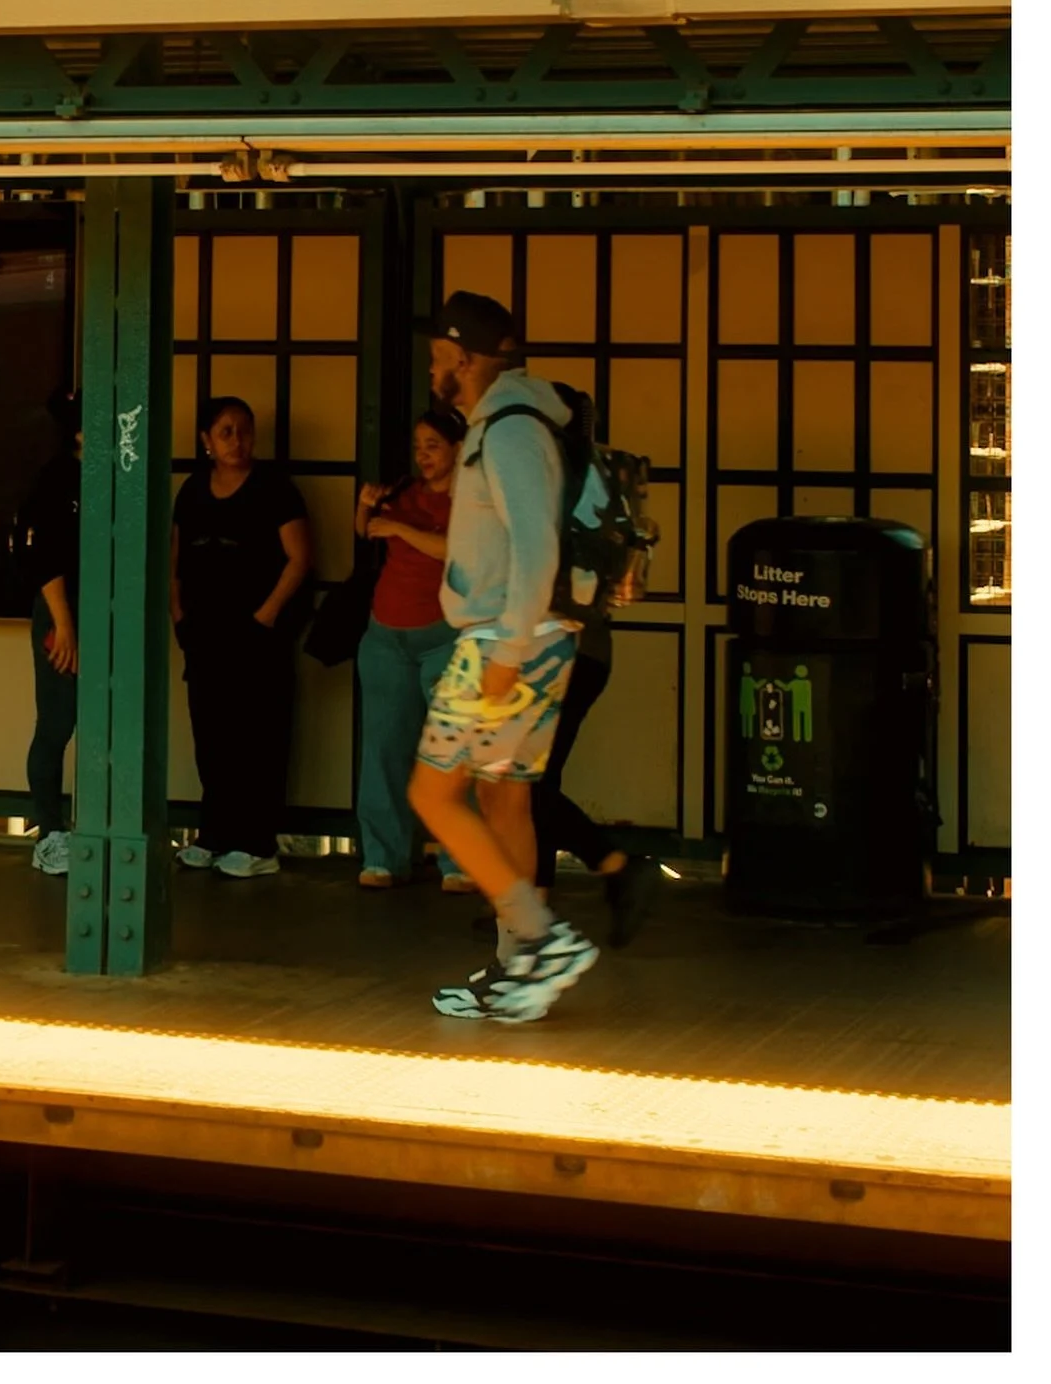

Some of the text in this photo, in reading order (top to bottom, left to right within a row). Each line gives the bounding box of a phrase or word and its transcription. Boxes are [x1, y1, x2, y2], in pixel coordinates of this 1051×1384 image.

[754, 564, 804, 583] Litter
[737, 584, 831, 608] Stops Here
[751, 773, 766, 783] You
[767, 775, 783, 785] Can
